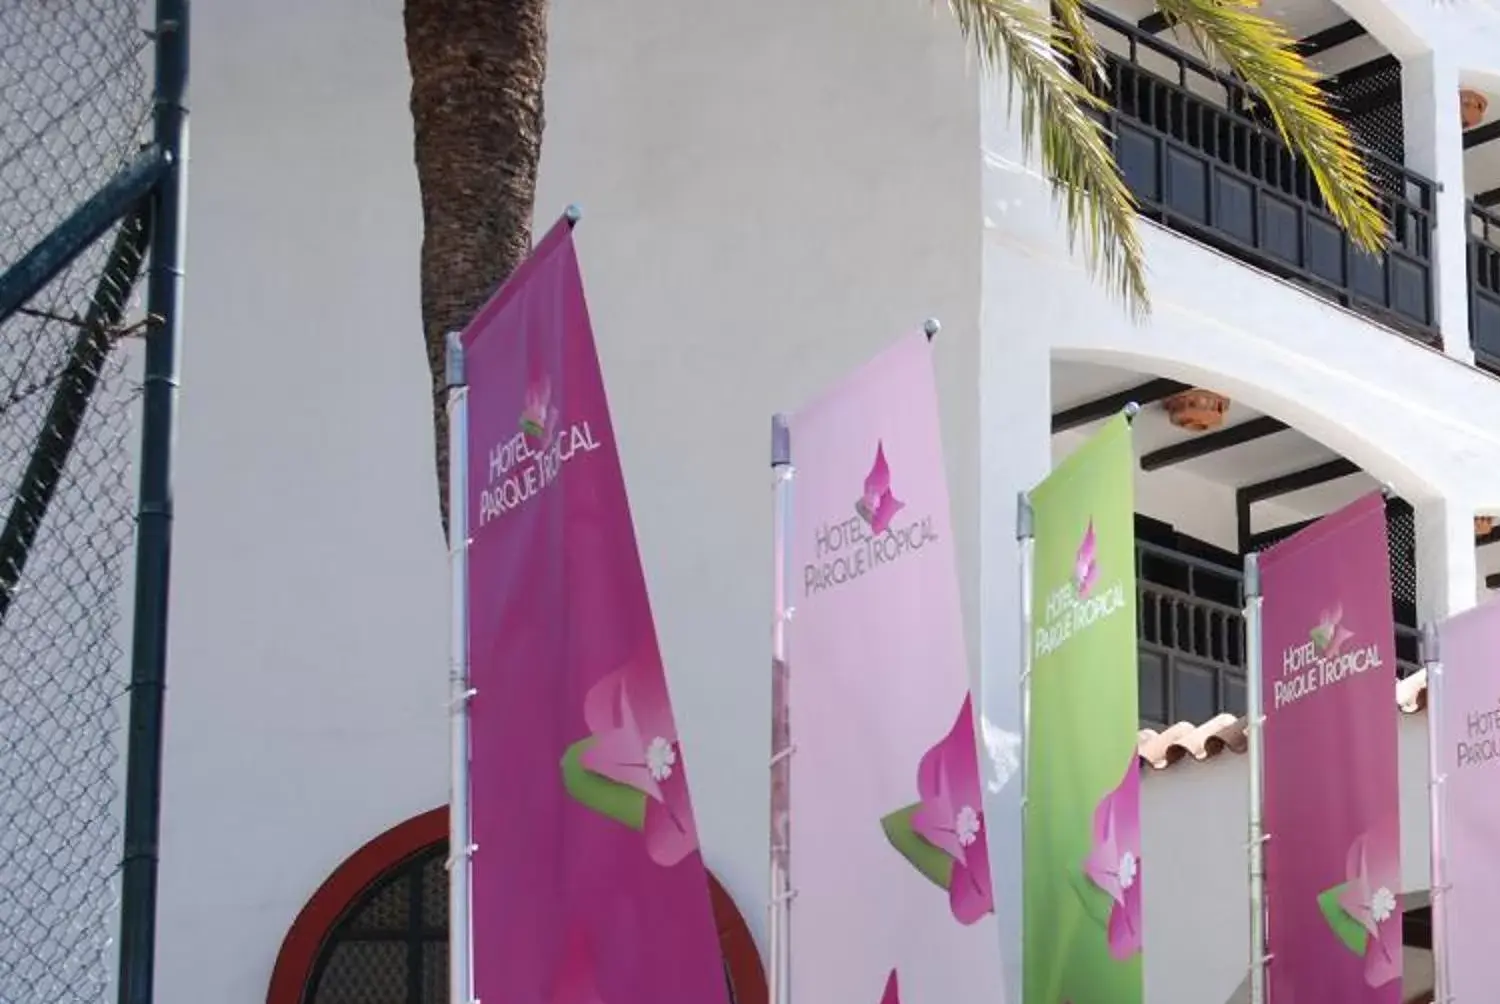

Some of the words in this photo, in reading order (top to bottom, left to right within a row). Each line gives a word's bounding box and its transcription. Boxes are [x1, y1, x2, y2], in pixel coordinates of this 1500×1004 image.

[488, 431, 536, 485] HOTEL
[814, 516, 866, 560] HOTEL
[1283, 640, 1319, 677] HOTEL
